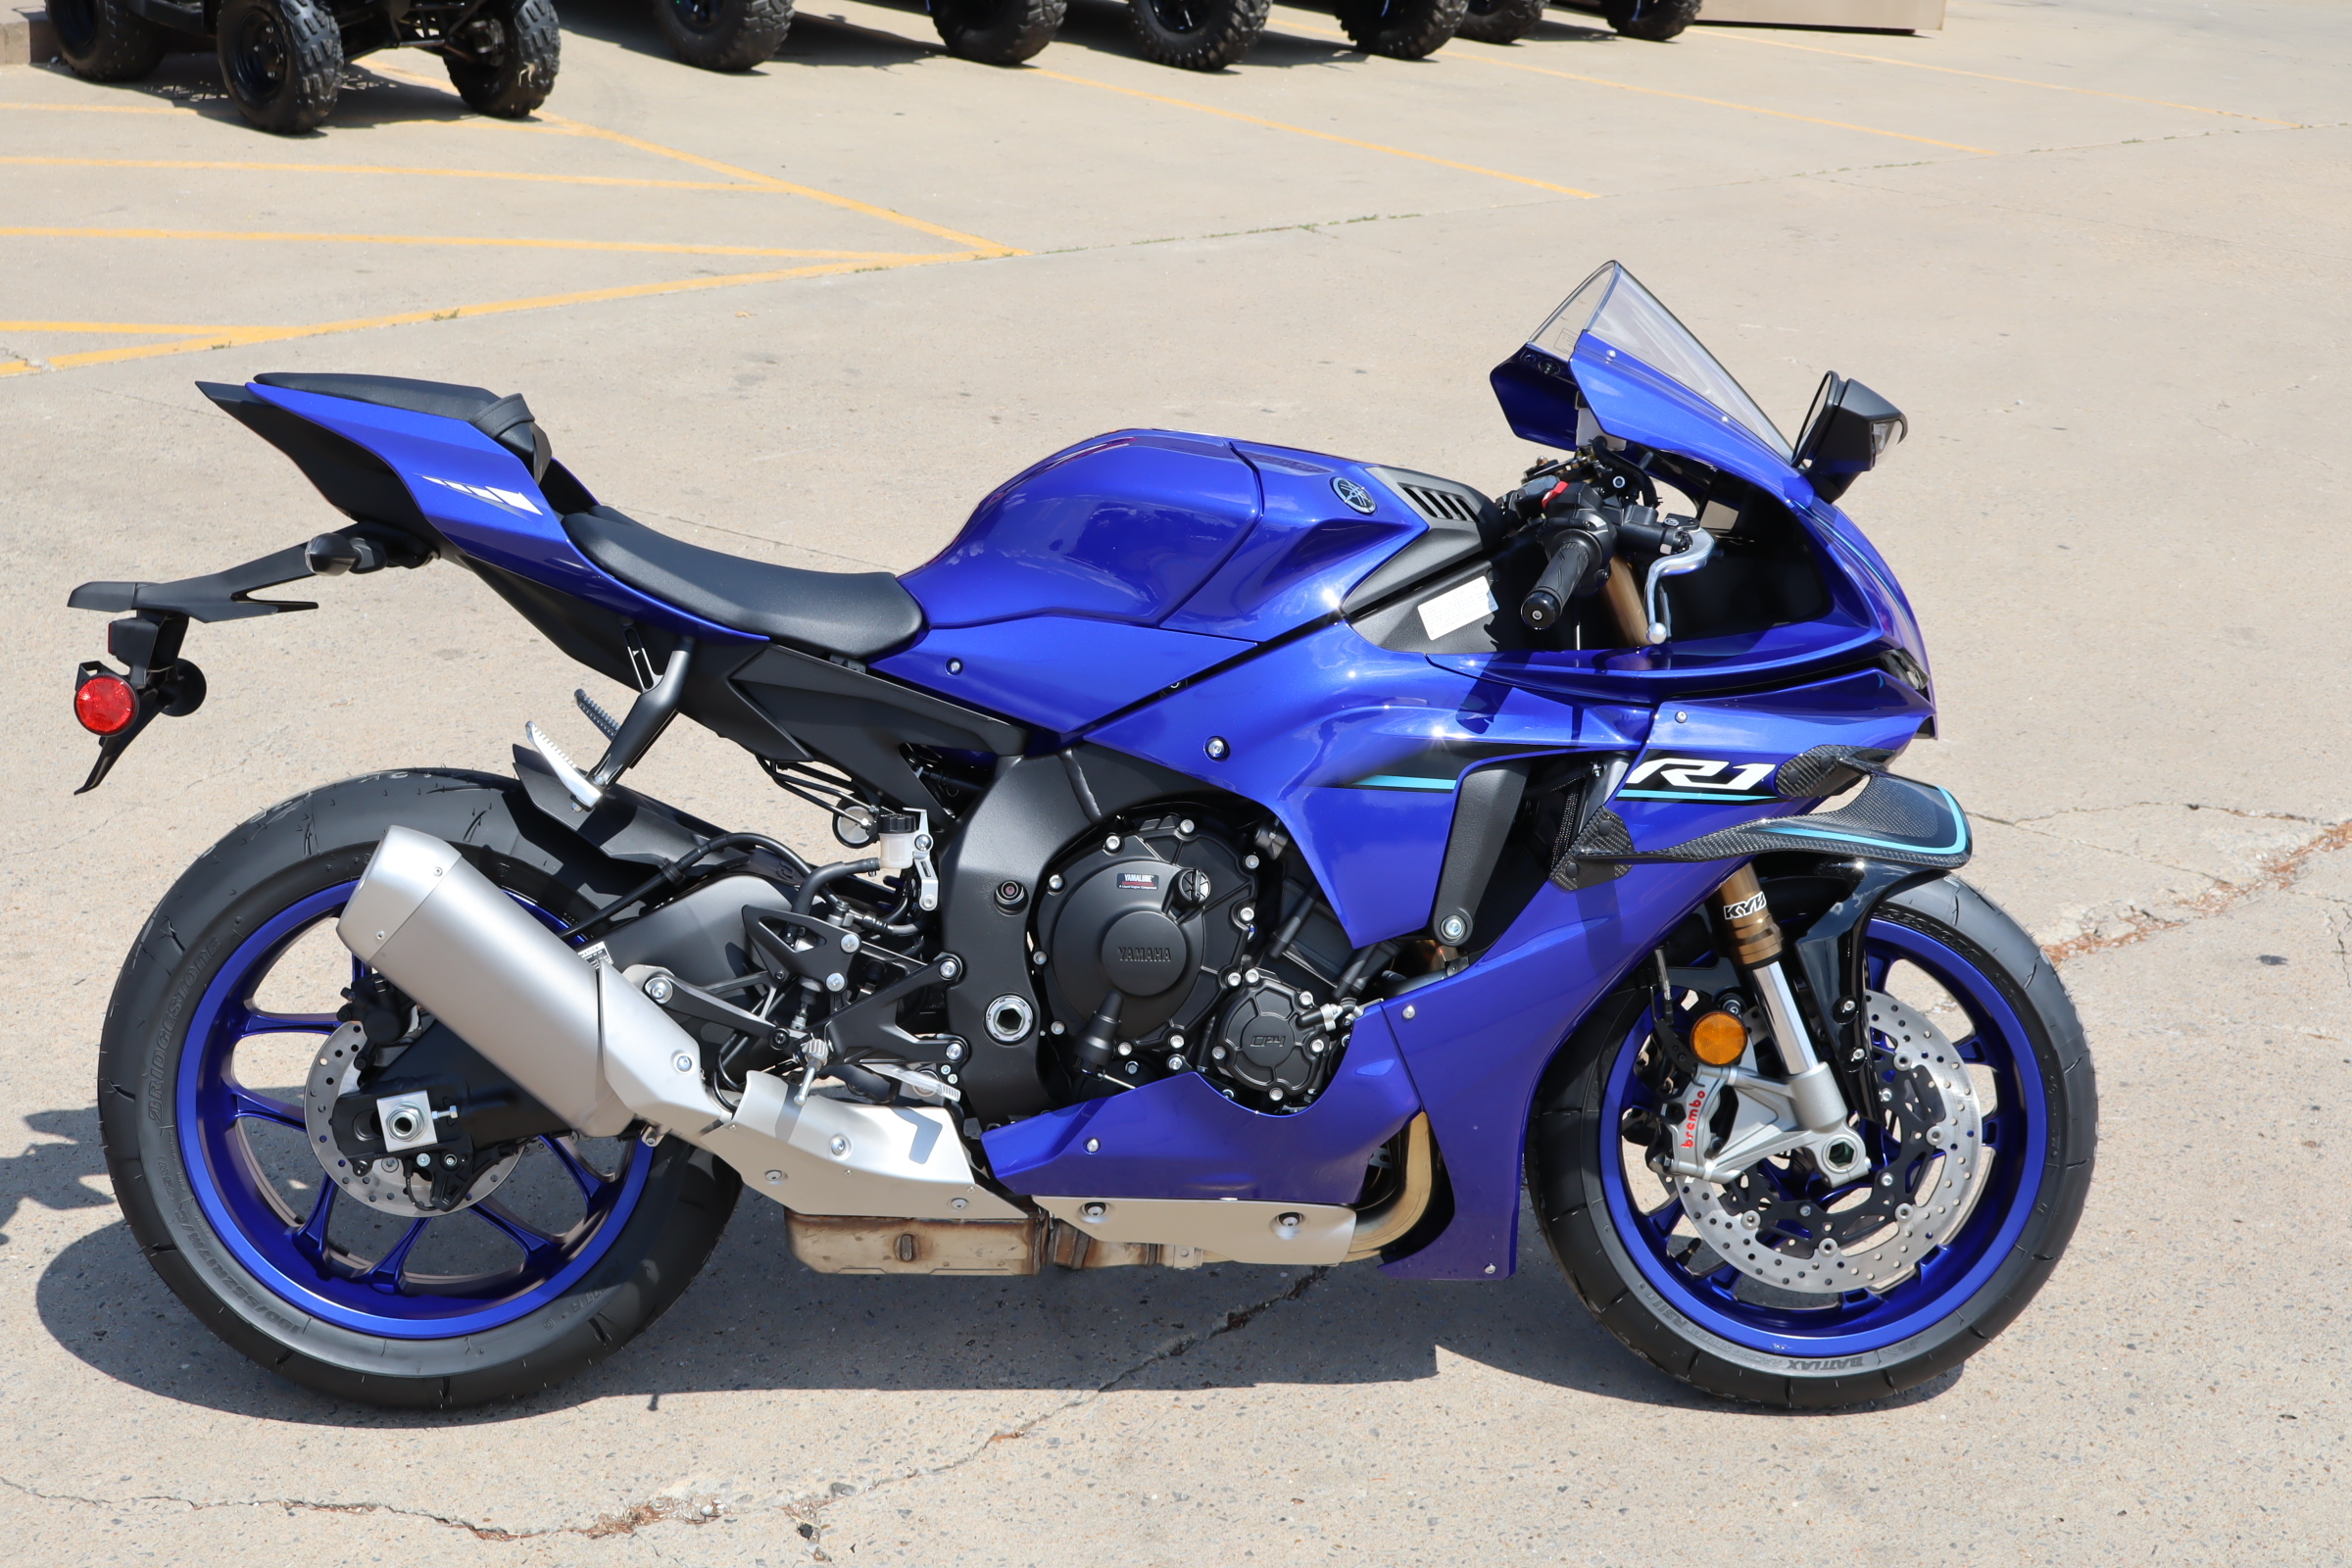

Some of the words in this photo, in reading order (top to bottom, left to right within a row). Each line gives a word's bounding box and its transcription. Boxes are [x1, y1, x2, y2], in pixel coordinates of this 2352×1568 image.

[1625, 758, 1777, 791] R1
[1117, 947, 1172, 962] YAMAHA
[148, 936, 221, 1123] BRIDGESTONE
[1681, 1091, 1706, 1149] brembo
[1788, 1357, 1863, 1371] BATTLAX
